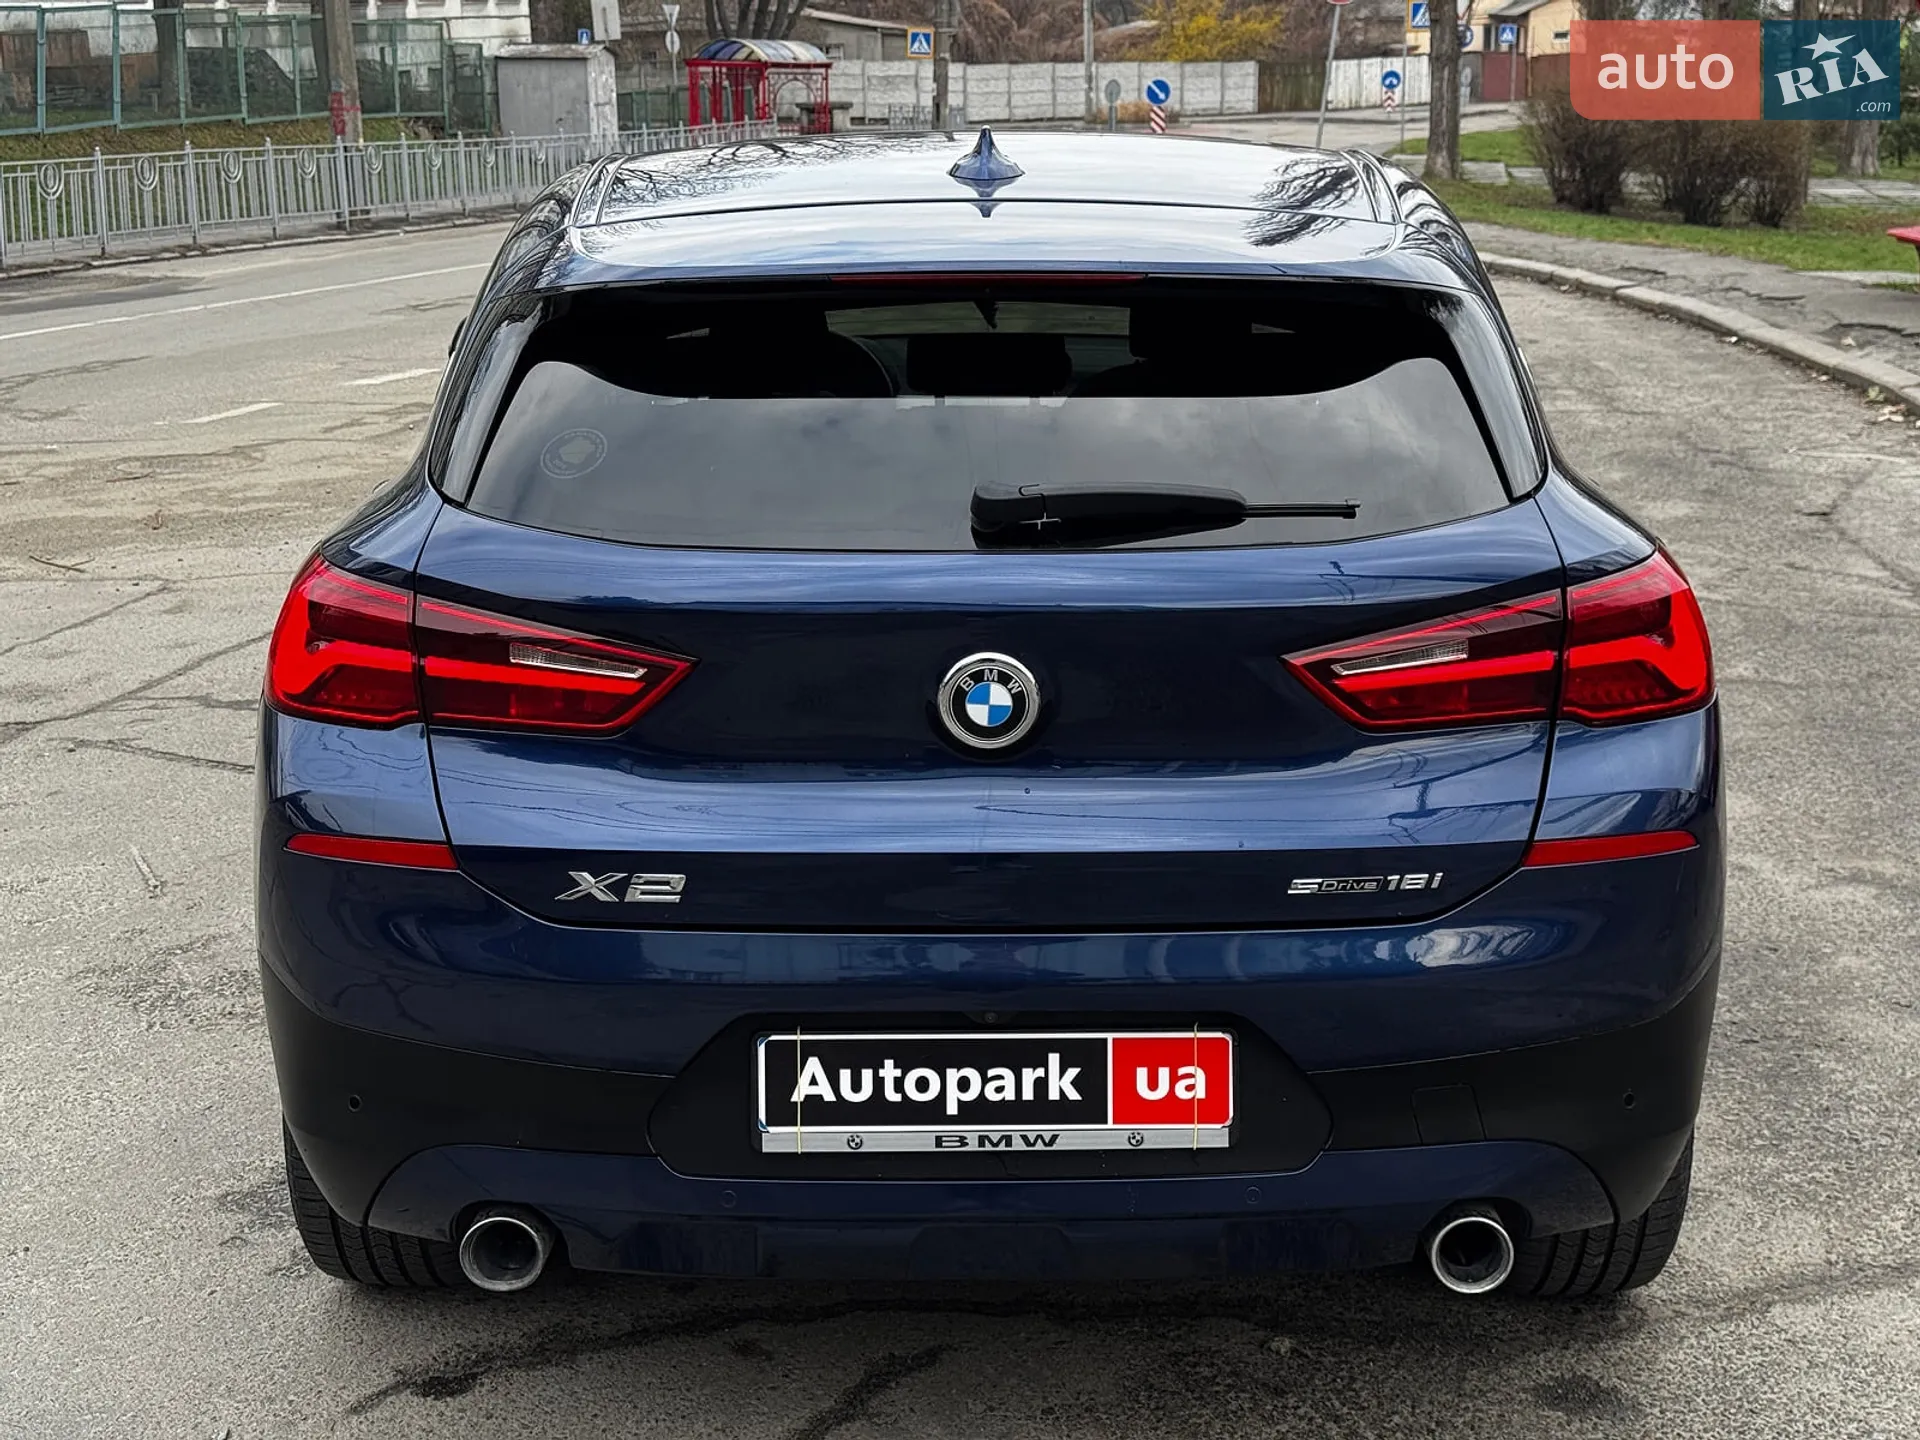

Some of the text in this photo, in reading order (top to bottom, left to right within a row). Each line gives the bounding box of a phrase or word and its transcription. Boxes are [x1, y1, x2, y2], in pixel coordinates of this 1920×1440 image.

[959, 669, 1022, 695] BMW
[554, 871, 686, 903] X2
[790, 1053, 1206, 1115] Autopark ua
[934, 1133, 1061, 1149] BMW
